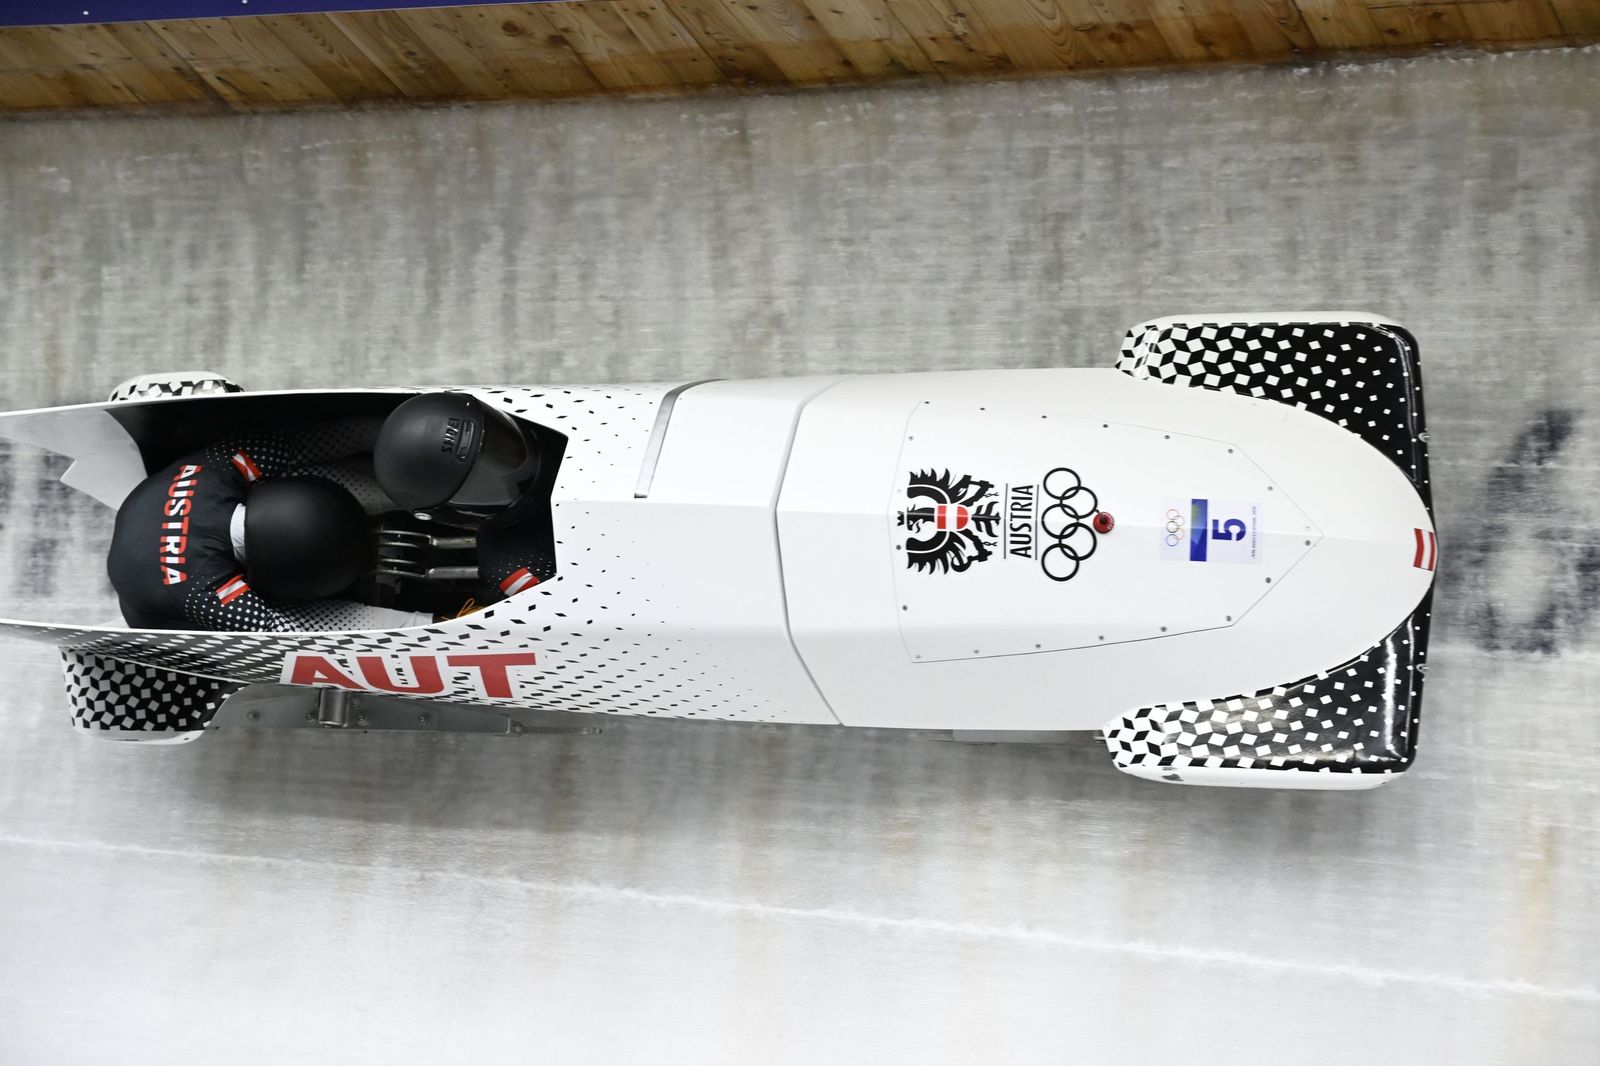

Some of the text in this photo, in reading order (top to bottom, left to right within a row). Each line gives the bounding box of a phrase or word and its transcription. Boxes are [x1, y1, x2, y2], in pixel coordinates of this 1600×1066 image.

[160, 464, 202, 585] AUSTRIA
[1010, 484, 1034, 559] AUSTRIA
[1212, 518, 1247, 542] 5
[290, 652, 536, 699] AUT
